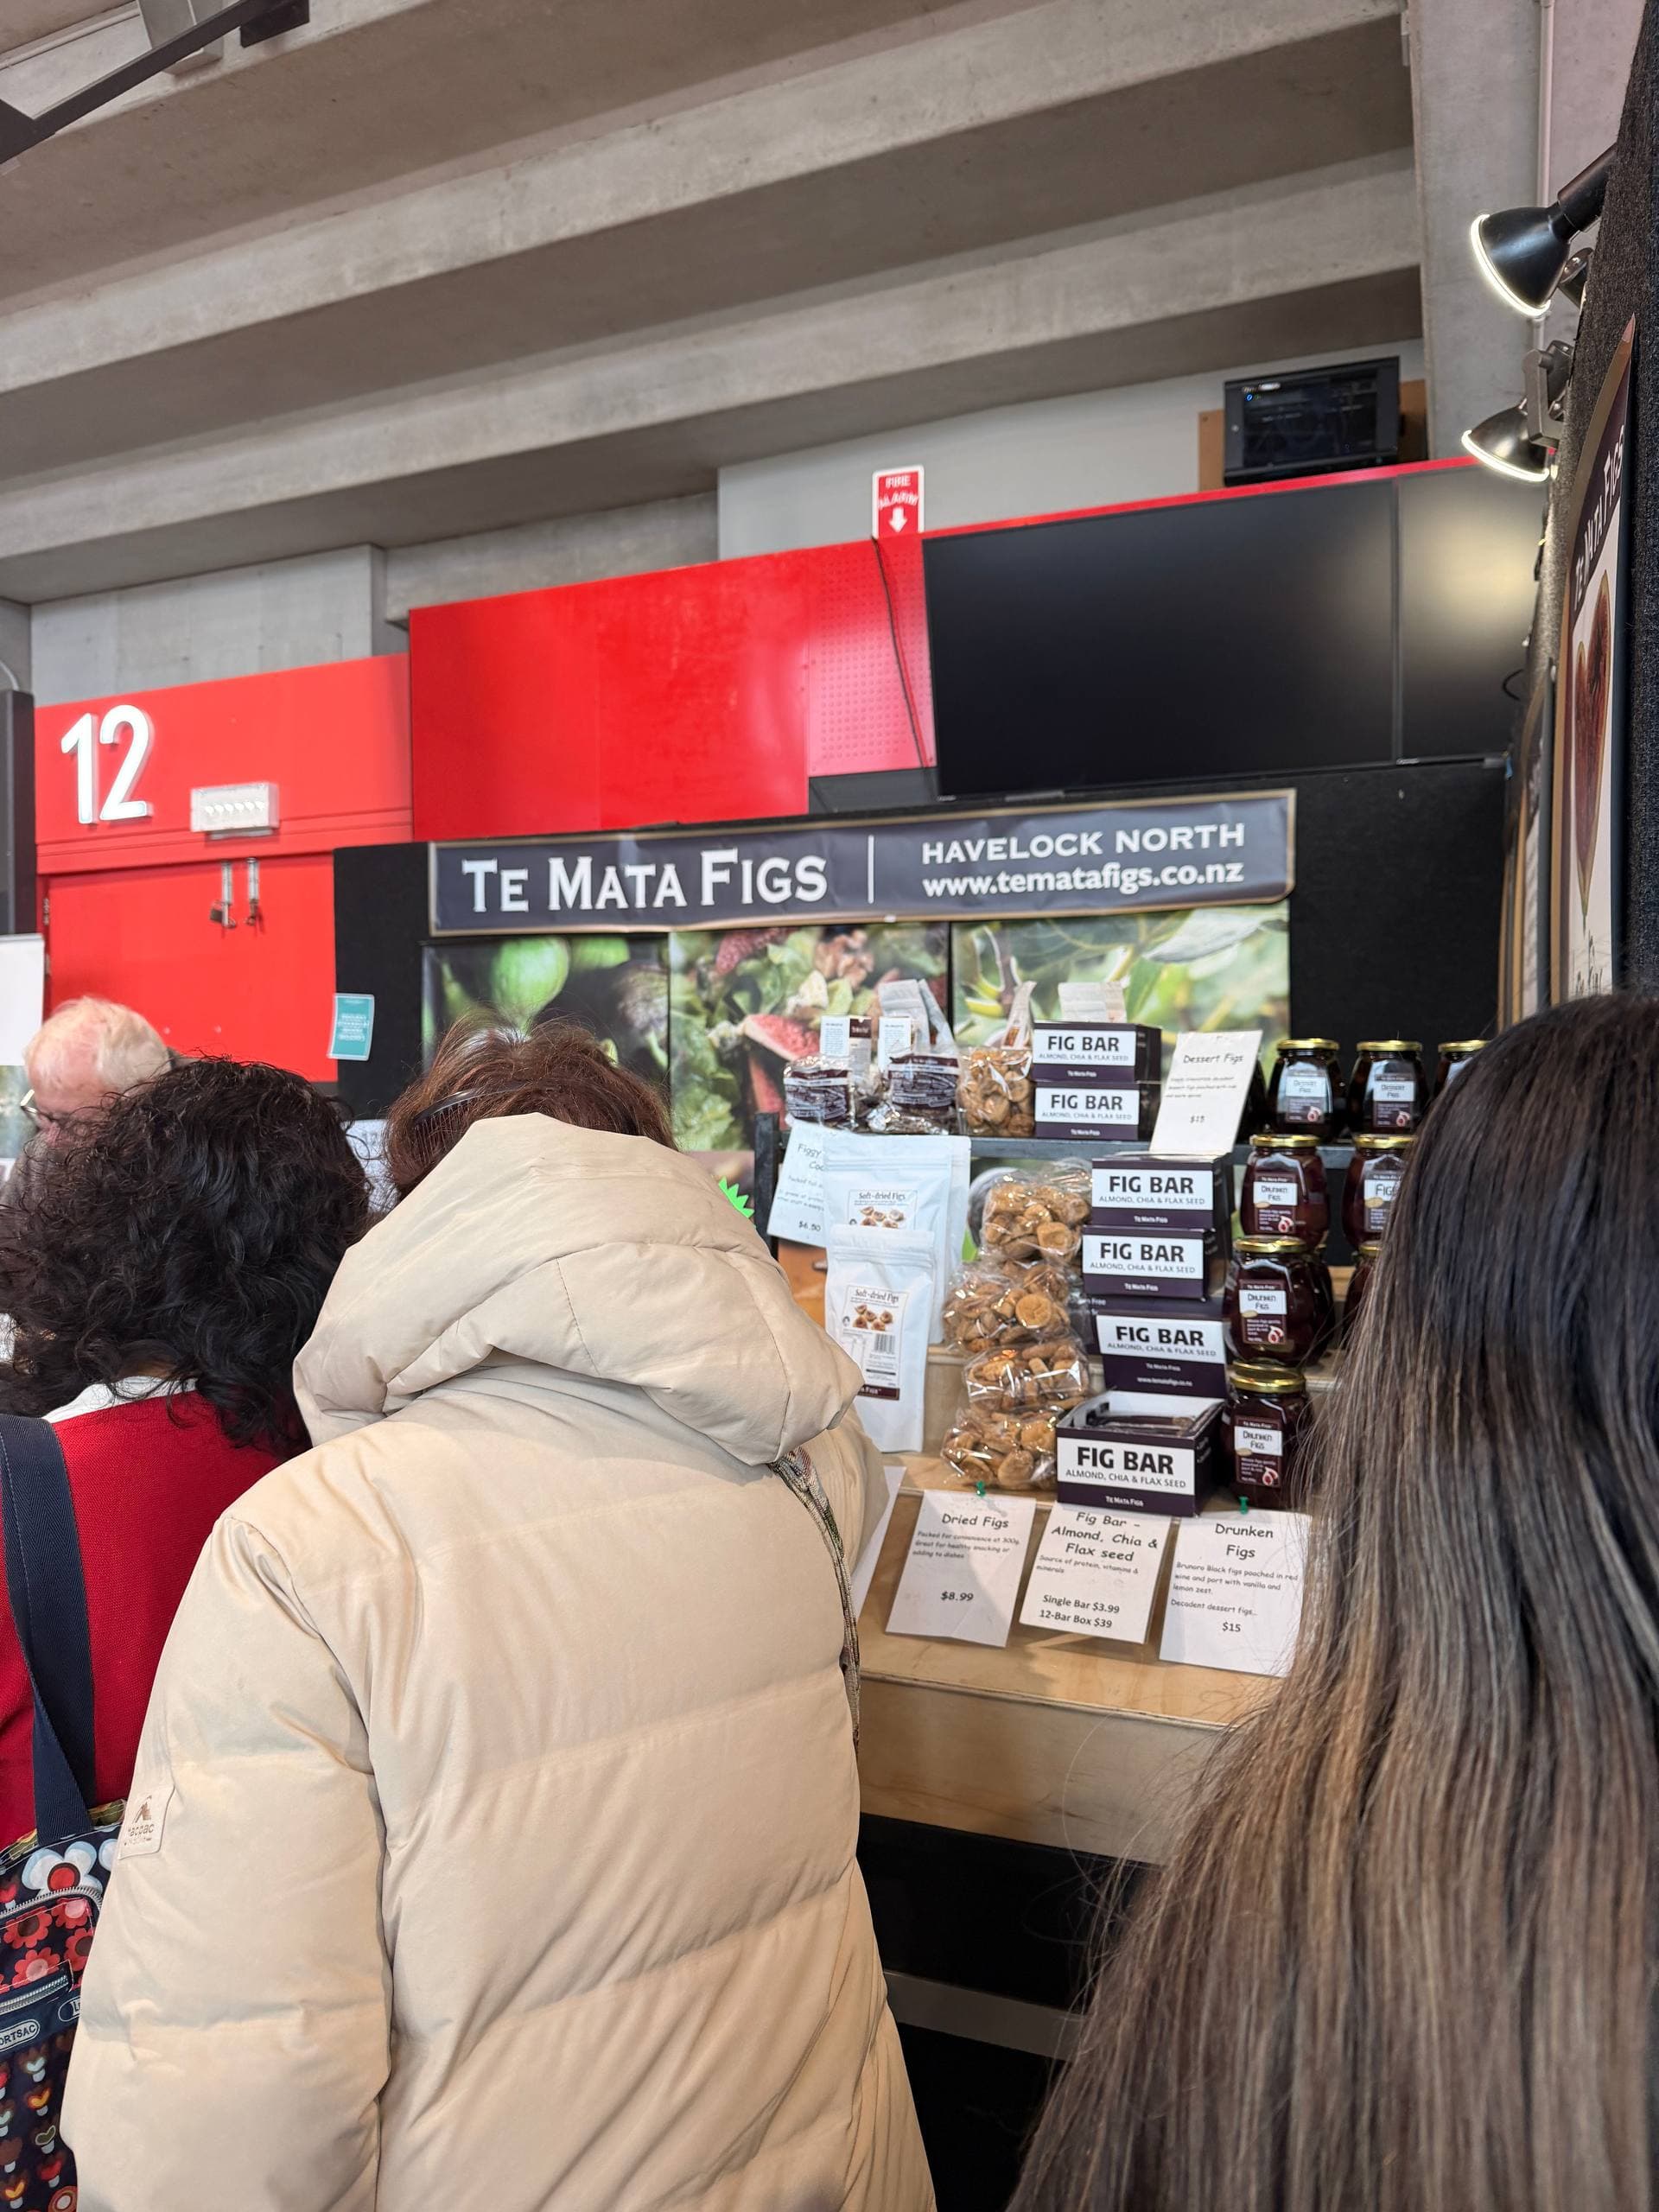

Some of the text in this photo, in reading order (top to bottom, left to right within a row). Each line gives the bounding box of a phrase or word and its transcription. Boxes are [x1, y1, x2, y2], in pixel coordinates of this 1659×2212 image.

[885, 475, 912, 489] FIRE
[60, 704, 153, 824] 12
[922, 823, 1245, 865] HAVELOCK NORTH
[462, 847, 828, 912] TE MATA FIGS
[922, 861, 1245, 897] www.tematafigs.co.nz
[1047, 1036, 1119, 1052] FIG BAR
[1183, 1053, 1244, 1065] Dessert Figs
[1051, 1095, 1122, 1110] FIG BAR
[798, 1143, 821, 1159] Figgy
[1109, 1176, 1193, 1194] FIG BAR
[858, 1192, 906, 1201] Soft-dried Figs
[1100, 1243, 1185, 1262] FIG BAR
[855, 1288, 887, 1300] Soft-dried
[887, 1292, 899, 1305] Figs
[1116, 1325, 1205, 1347] FIG BAR
[1077, 1446, 1174, 1475] FIG BAR
[1109, 1472, 1129, 1482] CHIA
[1141, 1477, 1162, 1486] FLAX
[1164, 1479, 1186, 1488] SEED
[942, 1513, 1009, 1529] Dried Figs
[1076, 1512, 1096, 1525] Fig
[1103, 1516, 1127, 1527] Bar
[1052, 1526, 1158, 1548] Almond, Chia &
[1215, 1523, 1274, 1538] Drunken
[1039, 1554, 1063, 1563] Source
[1065, 1543, 1135, 1561] Flax seed
[1226, 1544, 1255, 1560] Figs
[1036, 1565, 1065, 1574] minerals
[1206, 1563, 1226, 1573] Black
[1243, 1569, 1274, 1580] poached
[941, 1592, 974, 1602] $8.99
[1042, 1594, 1120, 1613] Single Bar $3.99
[1171, 1599, 1205, 1609] Decadent
[1207, 1604, 1236, 1613] dessert
[1039, 1610, 1113, 1628] 12-Bar Box $39
[1222, 1622, 1242, 1632] $15
